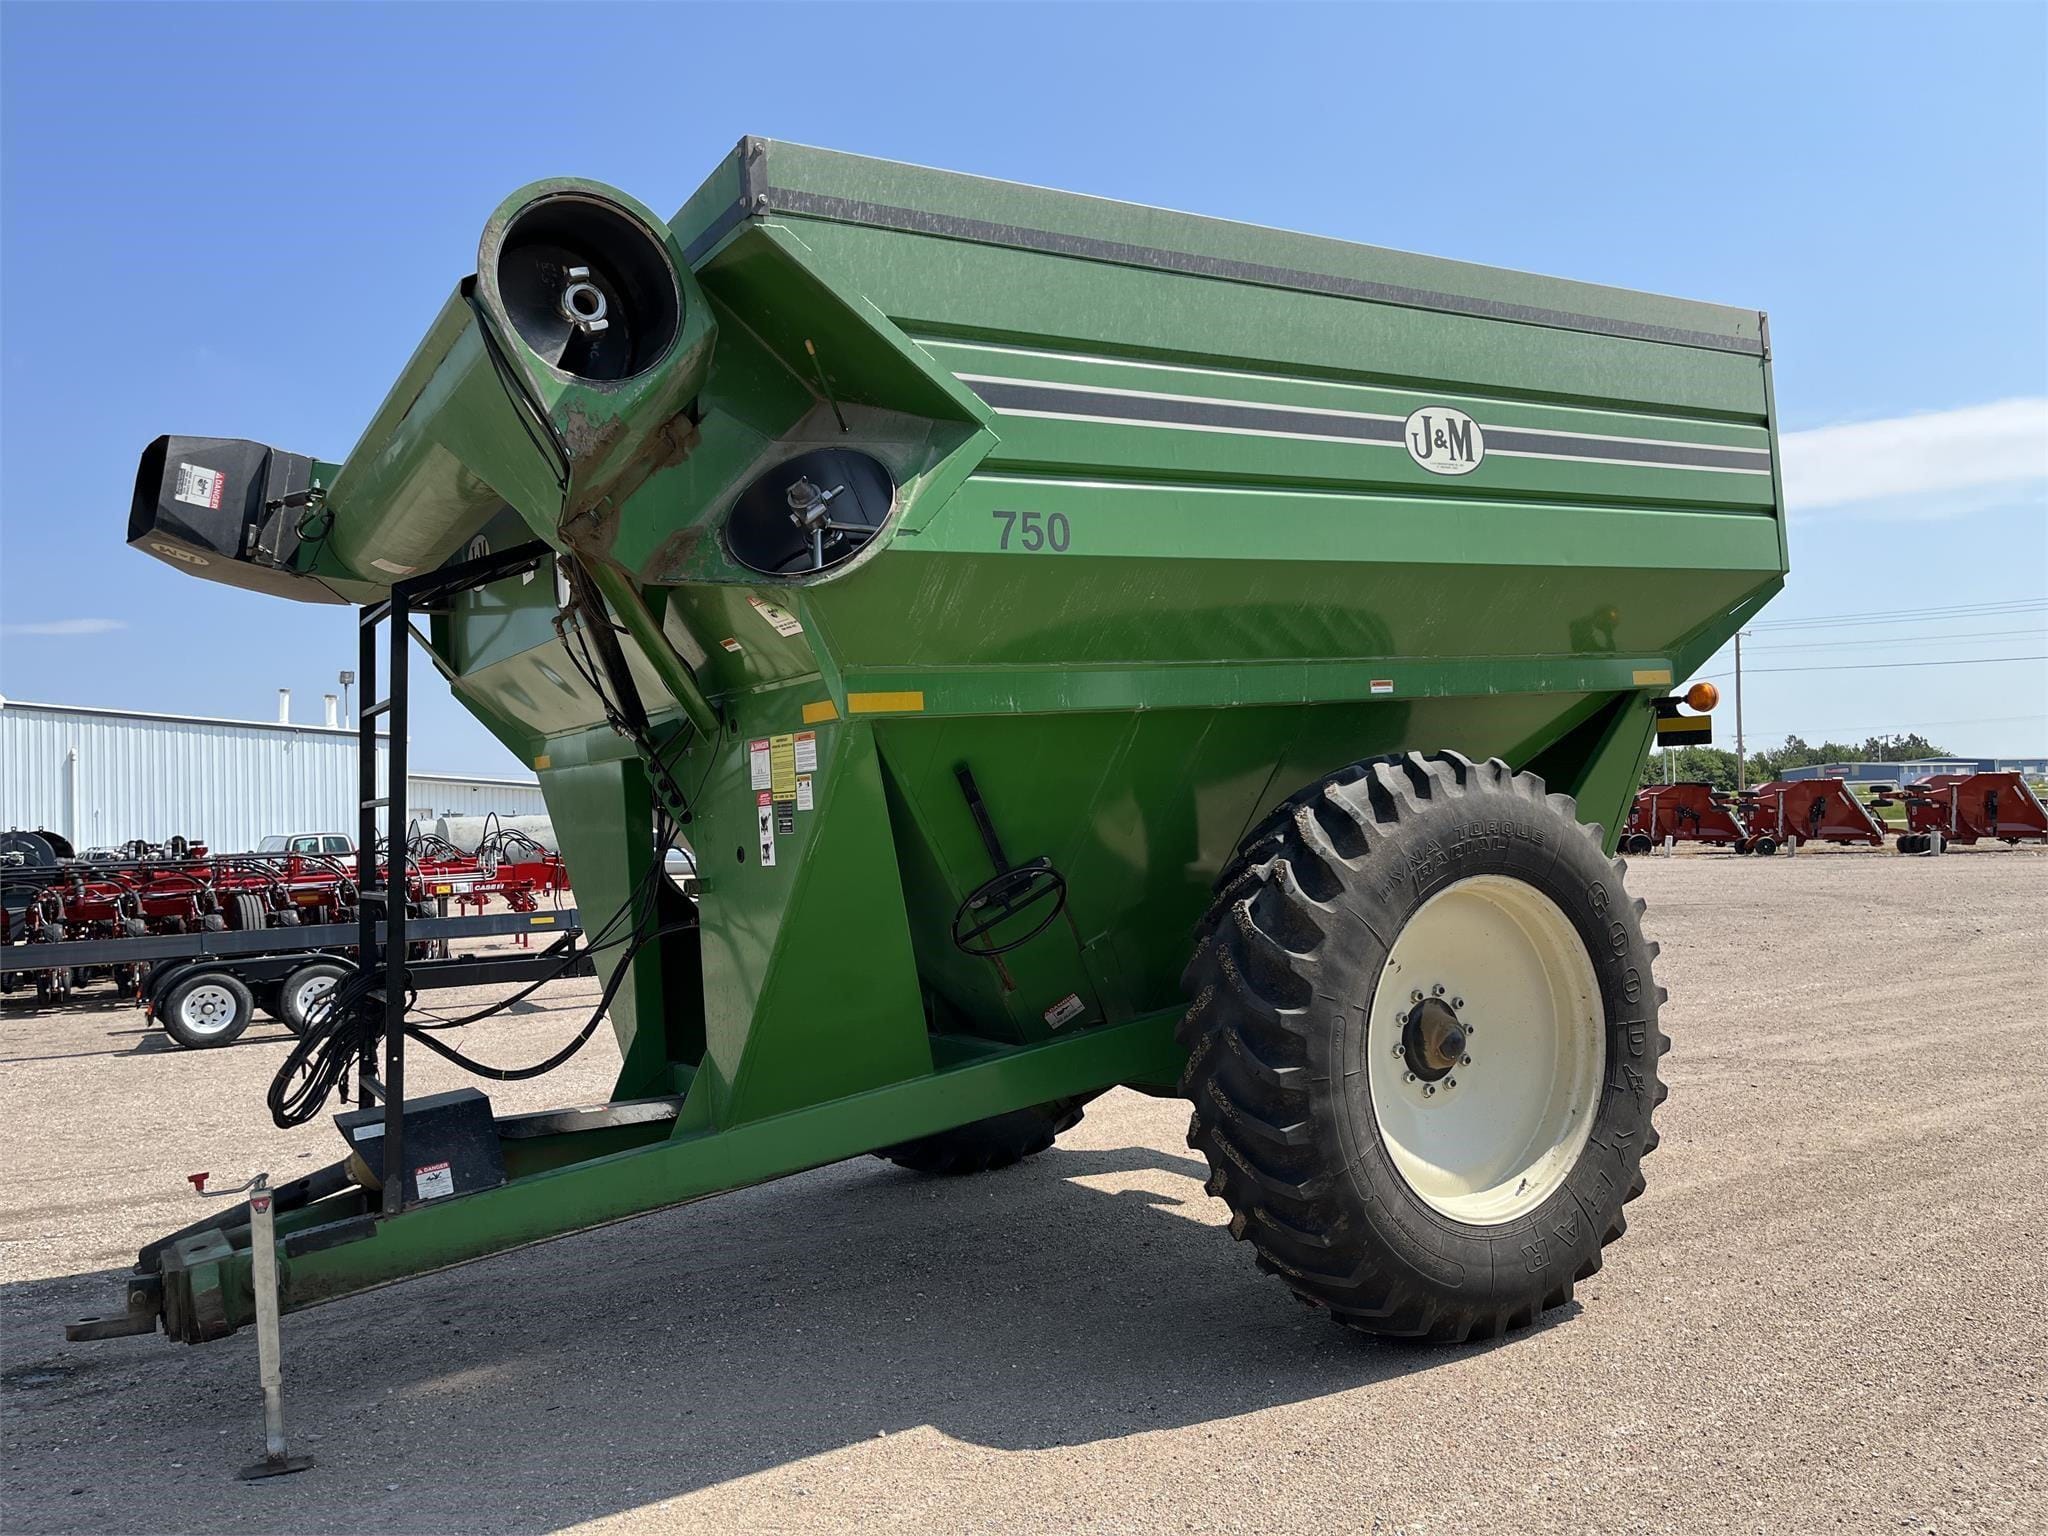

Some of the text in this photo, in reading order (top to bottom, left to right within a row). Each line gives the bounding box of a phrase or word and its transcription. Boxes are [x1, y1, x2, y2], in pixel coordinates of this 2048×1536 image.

[1411, 415, 1476, 463] J&M
[211, 480, 223, 509] DANGER
[992, 510, 1071, 552] 750
[1454, 819, 1546, 846] TORQUE
[1377, 838, 1442, 903] DYNA
[1416, 835, 1508, 881] RADIAL
[423, 1162, 448, 1173] DANGER
